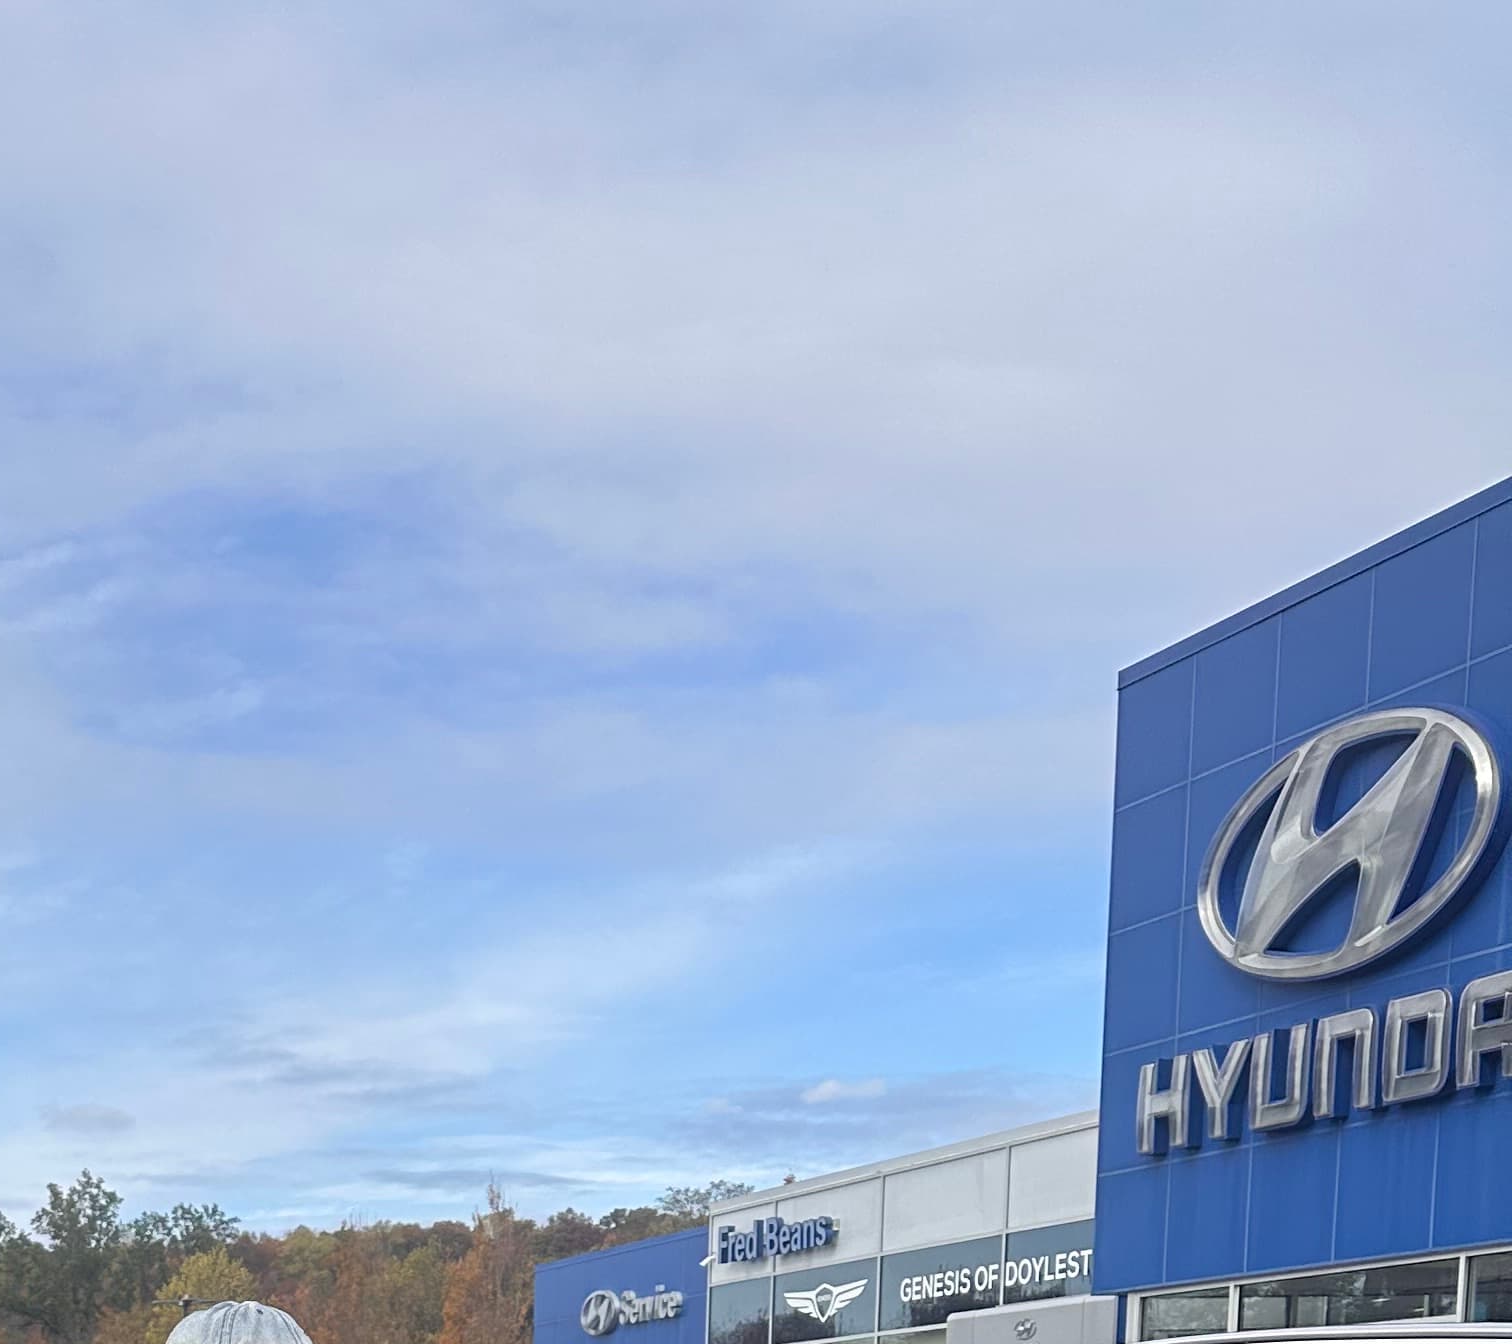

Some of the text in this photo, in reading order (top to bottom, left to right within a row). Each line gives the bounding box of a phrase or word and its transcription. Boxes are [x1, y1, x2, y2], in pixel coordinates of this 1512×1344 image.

[718, 1217, 830, 1264] Fred Beans
[899, 1249, 1094, 1303] GENESIS OF DOYLEST
[618, 1284, 683, 1326] Service
